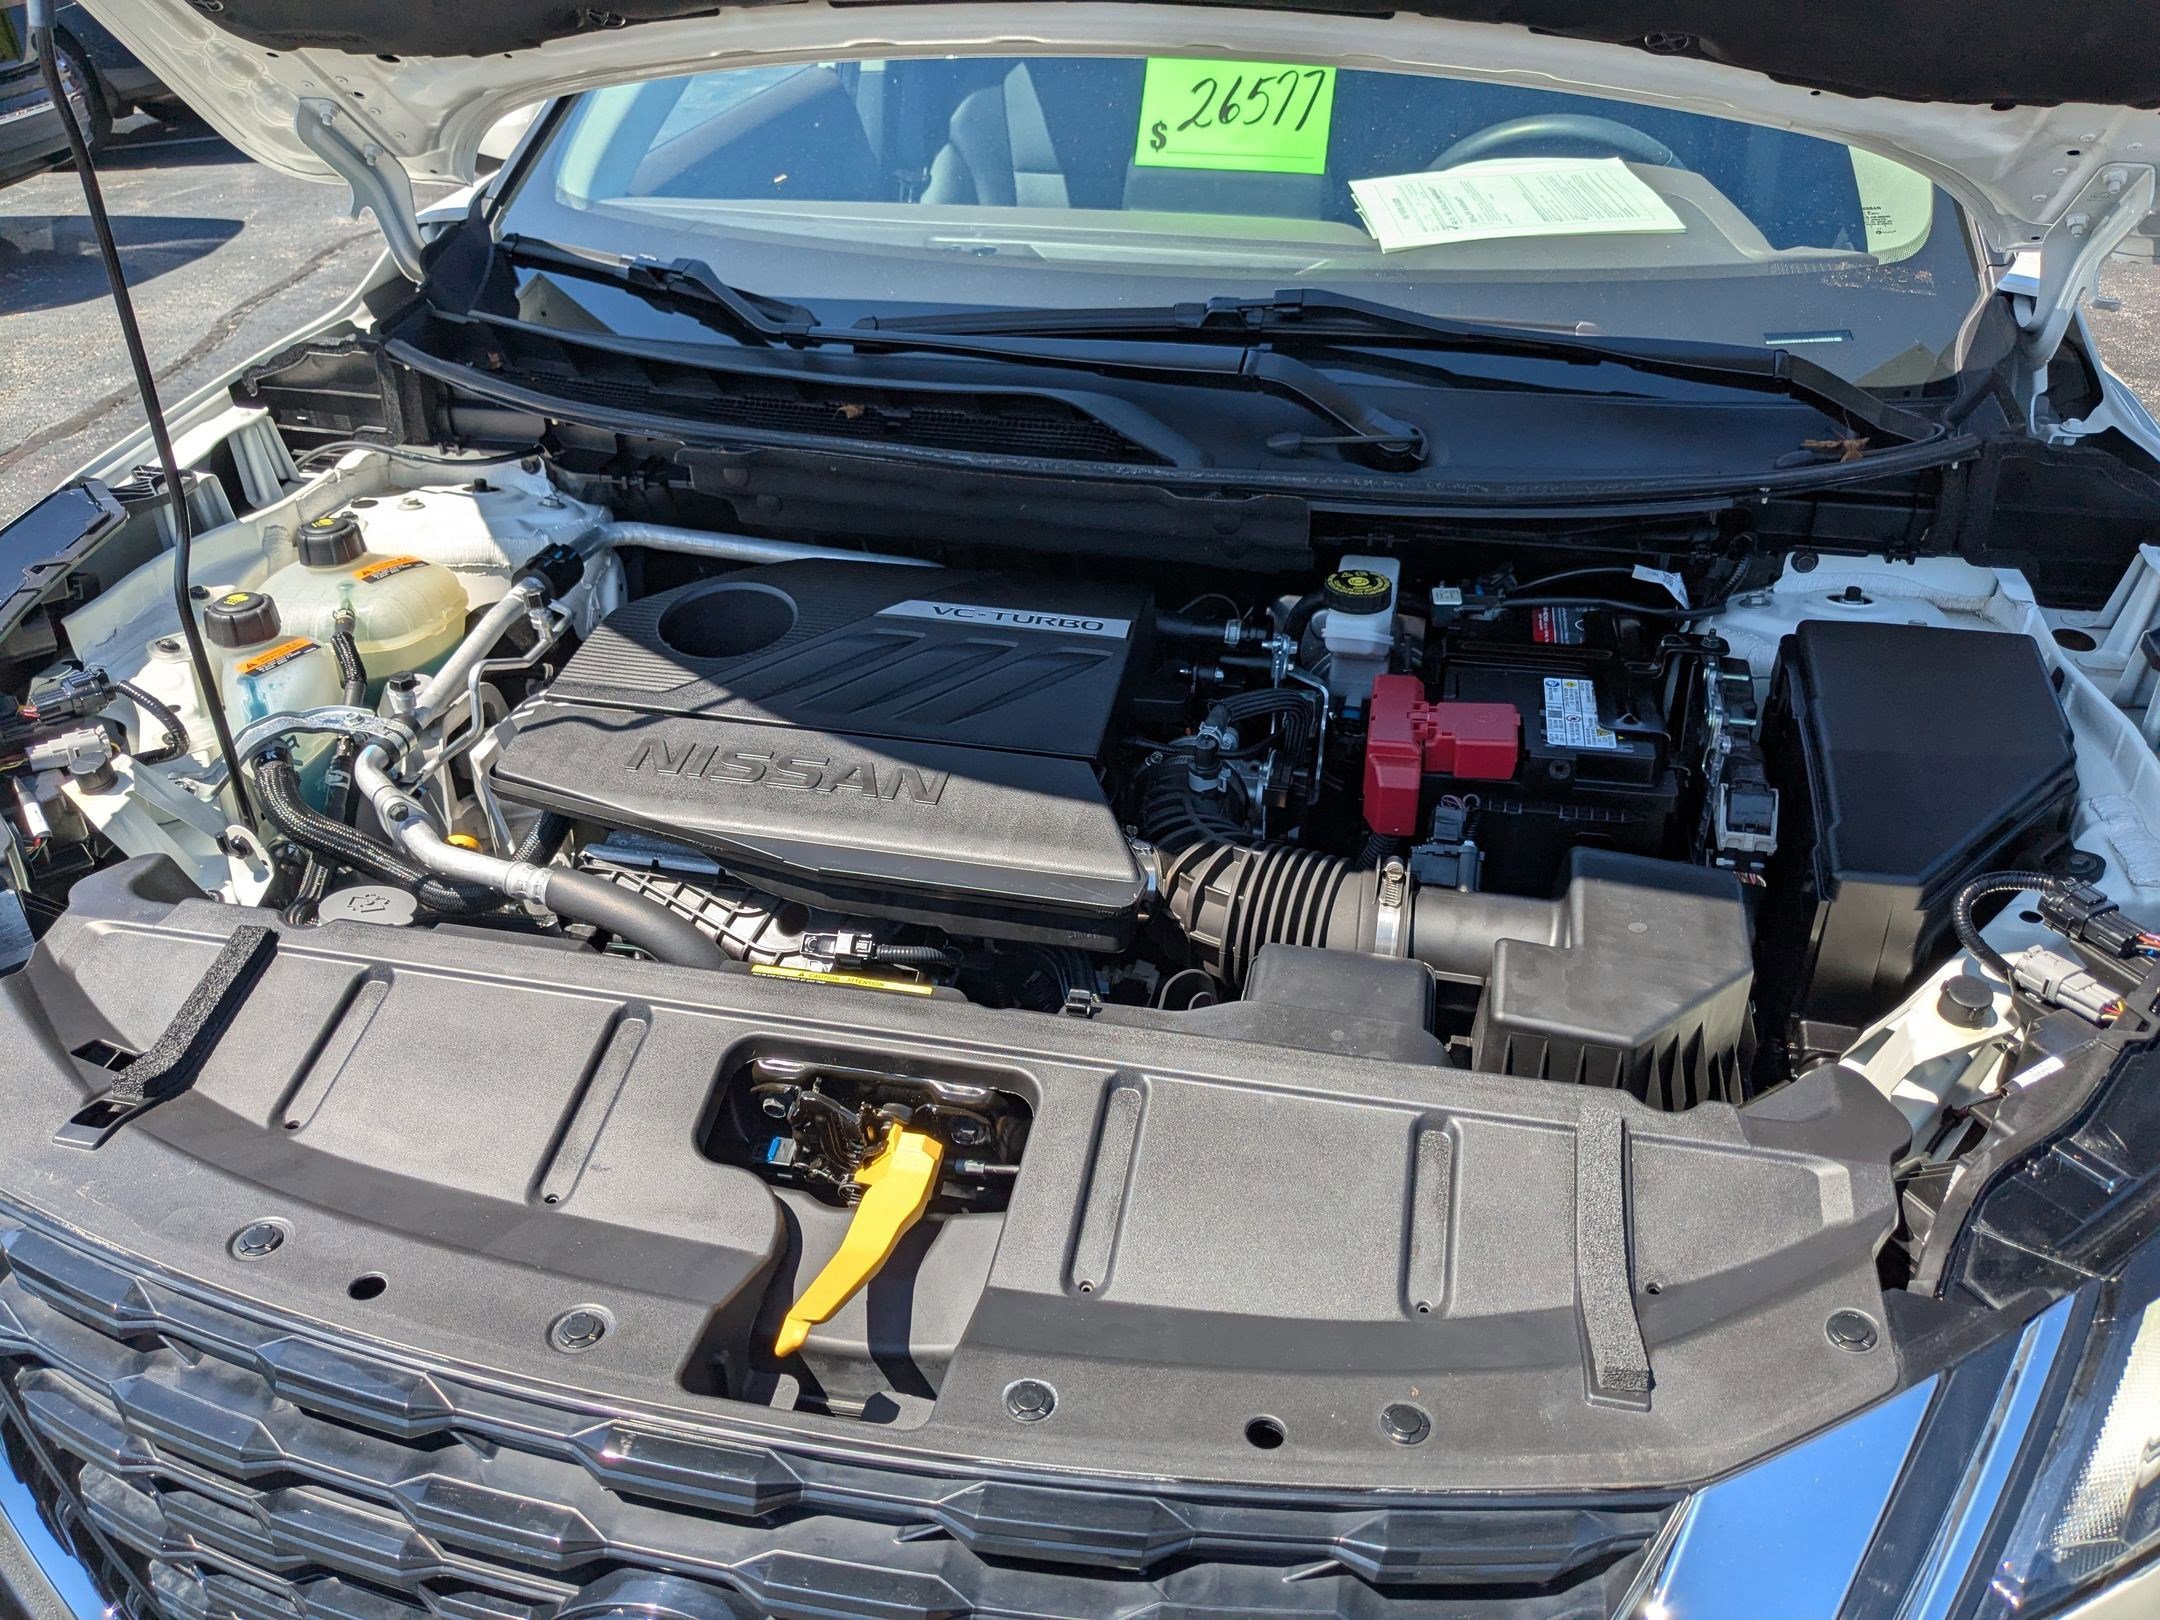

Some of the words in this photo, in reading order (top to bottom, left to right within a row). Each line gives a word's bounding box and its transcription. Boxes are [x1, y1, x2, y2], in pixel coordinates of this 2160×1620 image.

[1149, 120, 1168, 152] $
[1176, 69, 1326, 132] 26577
[932, 606, 1104, 631] VC-TURBO
[624, 736, 951, 805] NISSAN
[809, 973, 840, 982] CAUTION
[846, 975, 886, 987] ATTENTION
